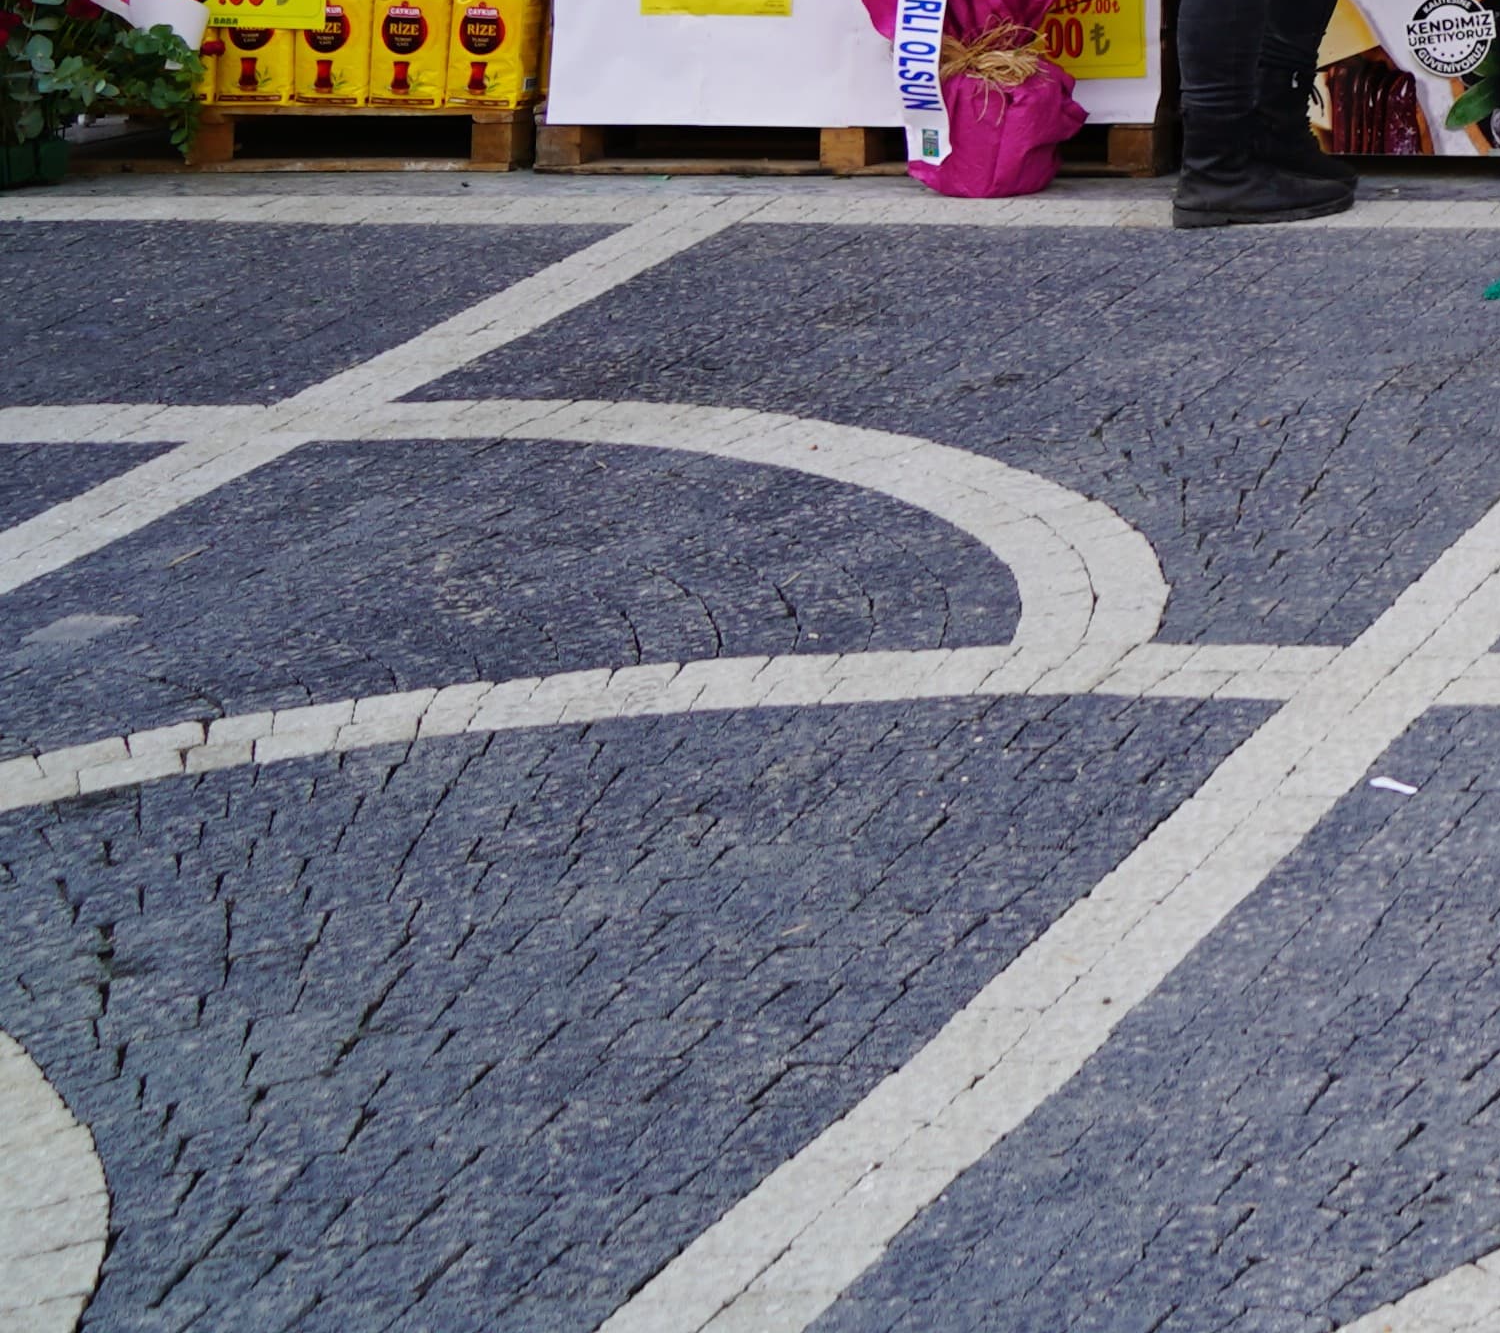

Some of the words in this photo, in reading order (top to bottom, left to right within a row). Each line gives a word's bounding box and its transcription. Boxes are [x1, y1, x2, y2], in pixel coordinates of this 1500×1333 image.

[1406, 13, 1492, 36] KENDİMİZ
[1408, 25, 1495, 48] ÜRETİYORUZ
[897, 39, 943, 112] OLSUN
